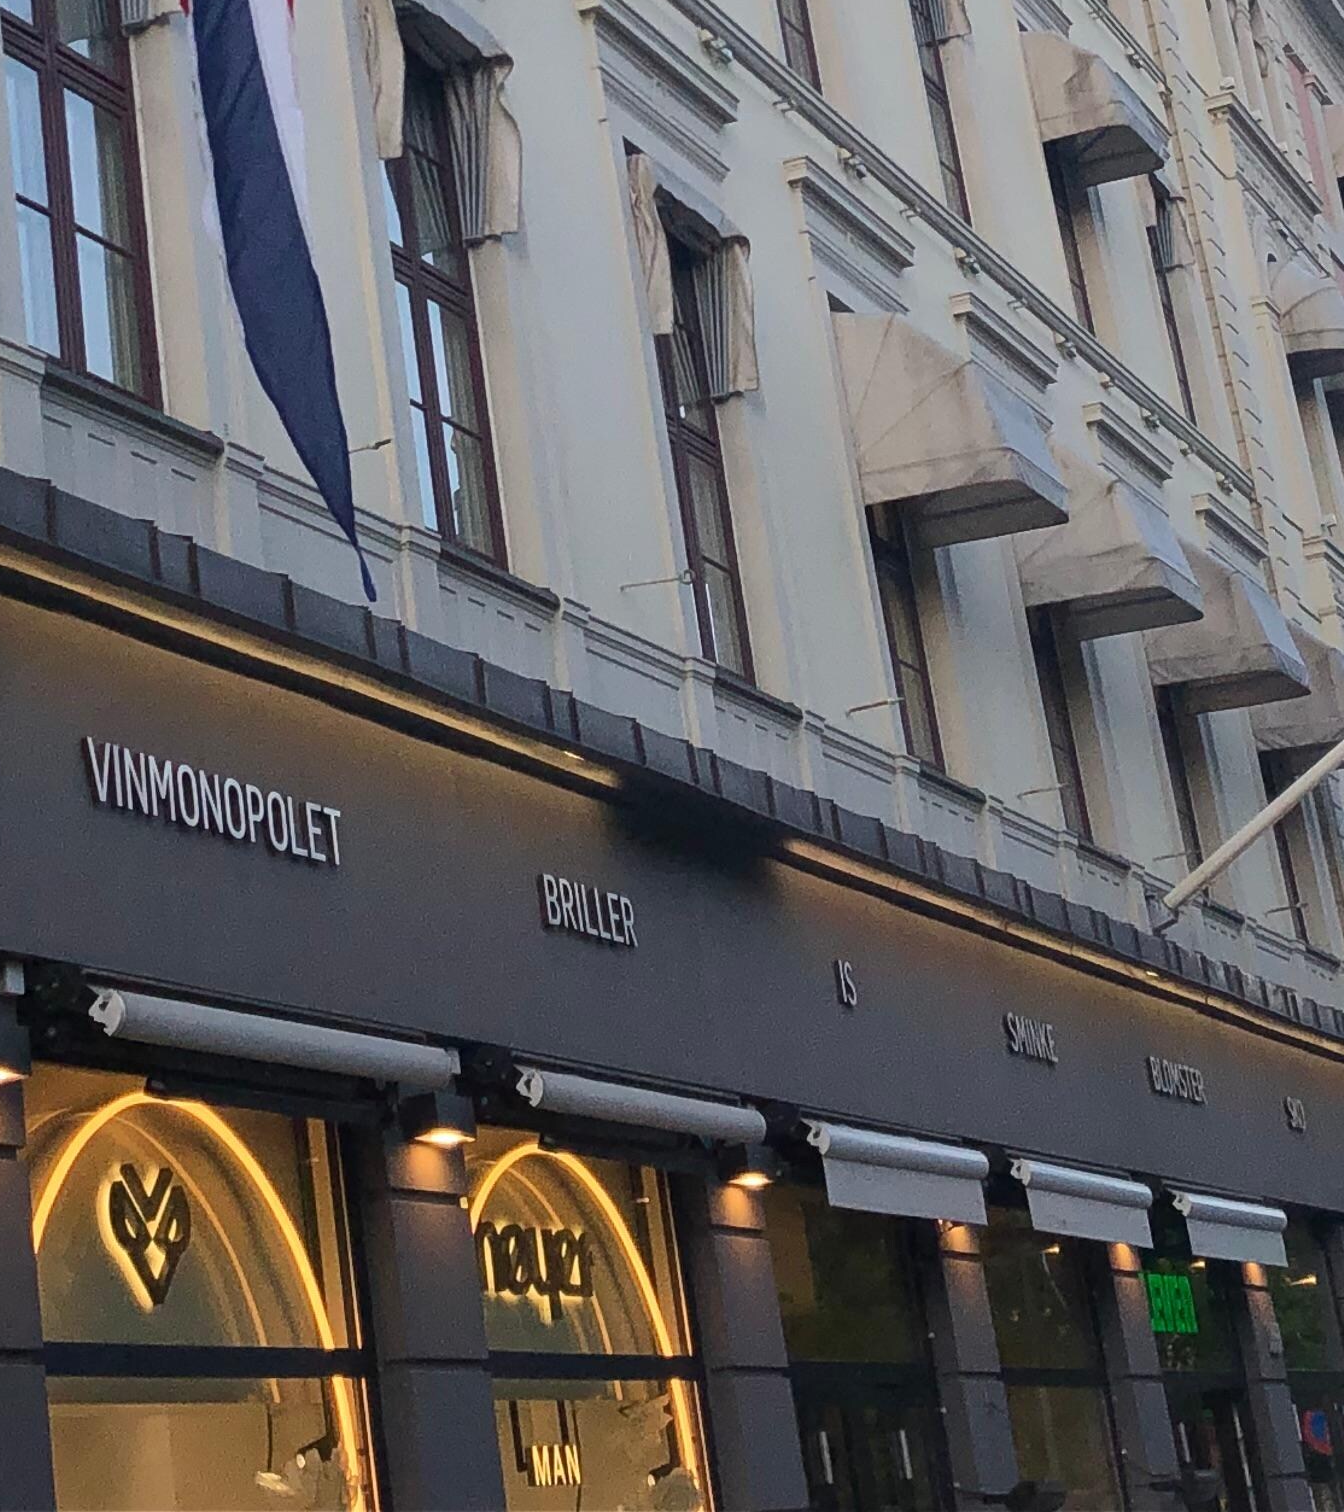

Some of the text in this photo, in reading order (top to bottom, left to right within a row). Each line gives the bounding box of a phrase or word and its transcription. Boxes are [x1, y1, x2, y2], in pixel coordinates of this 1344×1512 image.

[85, 735, 343, 867] VINMONOPOLET
[542, 873, 639, 948] BRILLER
[839, 959, 858, 1007] IS
[1006, 1011, 1059, 1063] SMINKE
[1149, 1055, 1209, 1105] BLOMSTER
[531, 1444, 582, 1487] MAN
